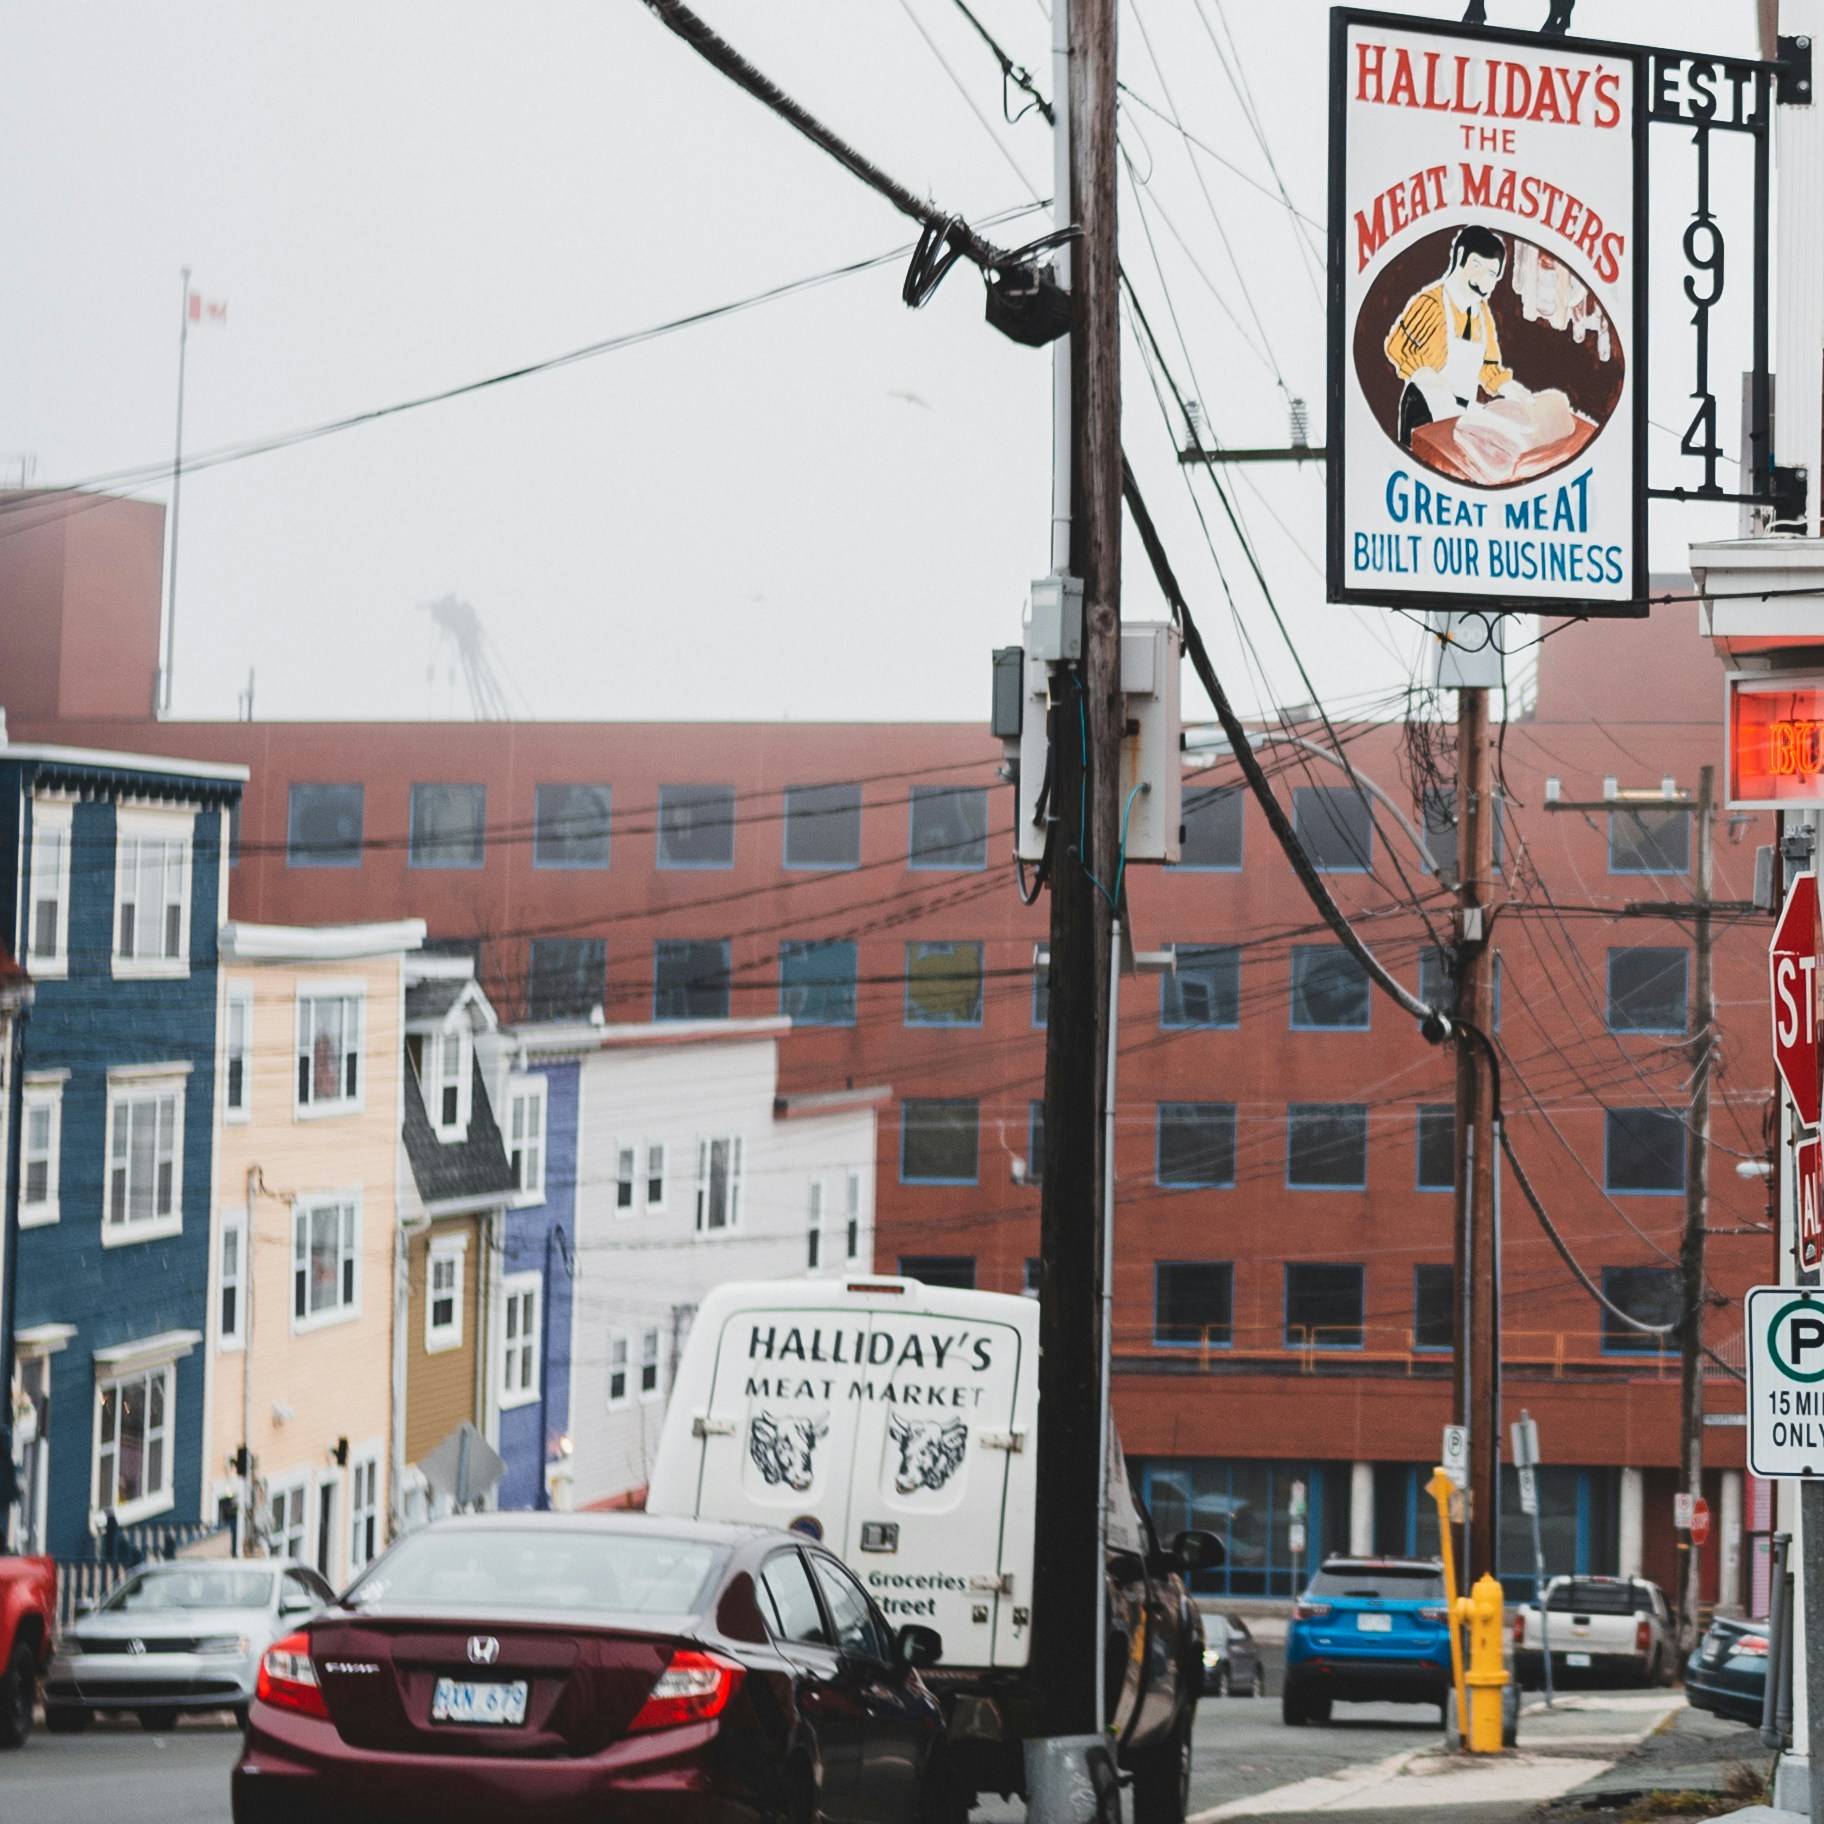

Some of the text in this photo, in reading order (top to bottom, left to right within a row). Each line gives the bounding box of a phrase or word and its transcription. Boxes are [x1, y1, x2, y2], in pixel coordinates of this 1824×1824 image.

[1356, 43, 1621, 129] HALLIDAY'S
[1460, 124, 1516, 154] THE
[1354, 162, 1625, 284] MEAT MASTERS
[1385, 467, 1594, 533] GREAT MEAT
[1354, 531, 1623, 584] BUILT OUR BUSINESS
[1777, 956, 1816, 1049] ST
[1804, 1172, 1822, 1238] AL
[749, 1327, 992, 1372] HALLIDAY'S
[745, 1377, 985, 1407] MEAT MARKET
[1769, 1390, 1790, 1415] 15
[869, 1570, 966, 1591] Groceries
